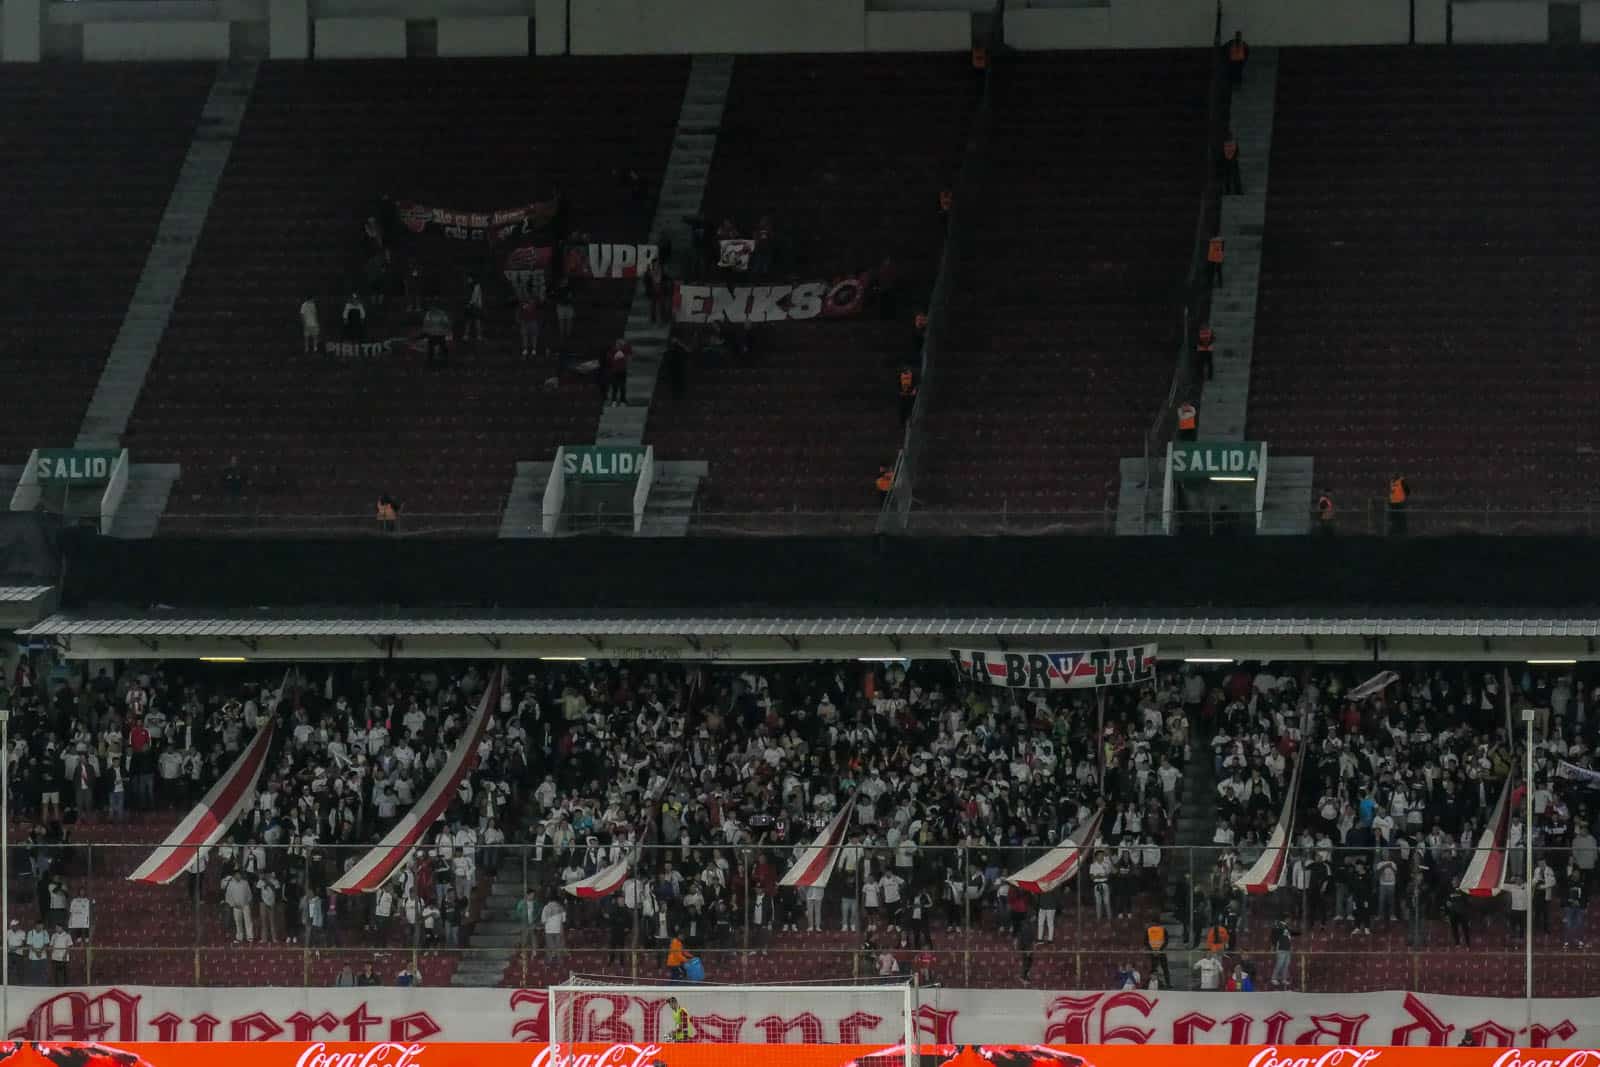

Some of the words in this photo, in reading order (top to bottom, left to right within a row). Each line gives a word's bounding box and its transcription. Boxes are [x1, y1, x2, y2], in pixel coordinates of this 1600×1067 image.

[1173, 450, 1259, 471] SALIDA
[1005, 646, 1154, 687] BRUTAL
[8, 988, 442, 1042] Muerte
[1045, 990, 1578, 1047] Ecuador
